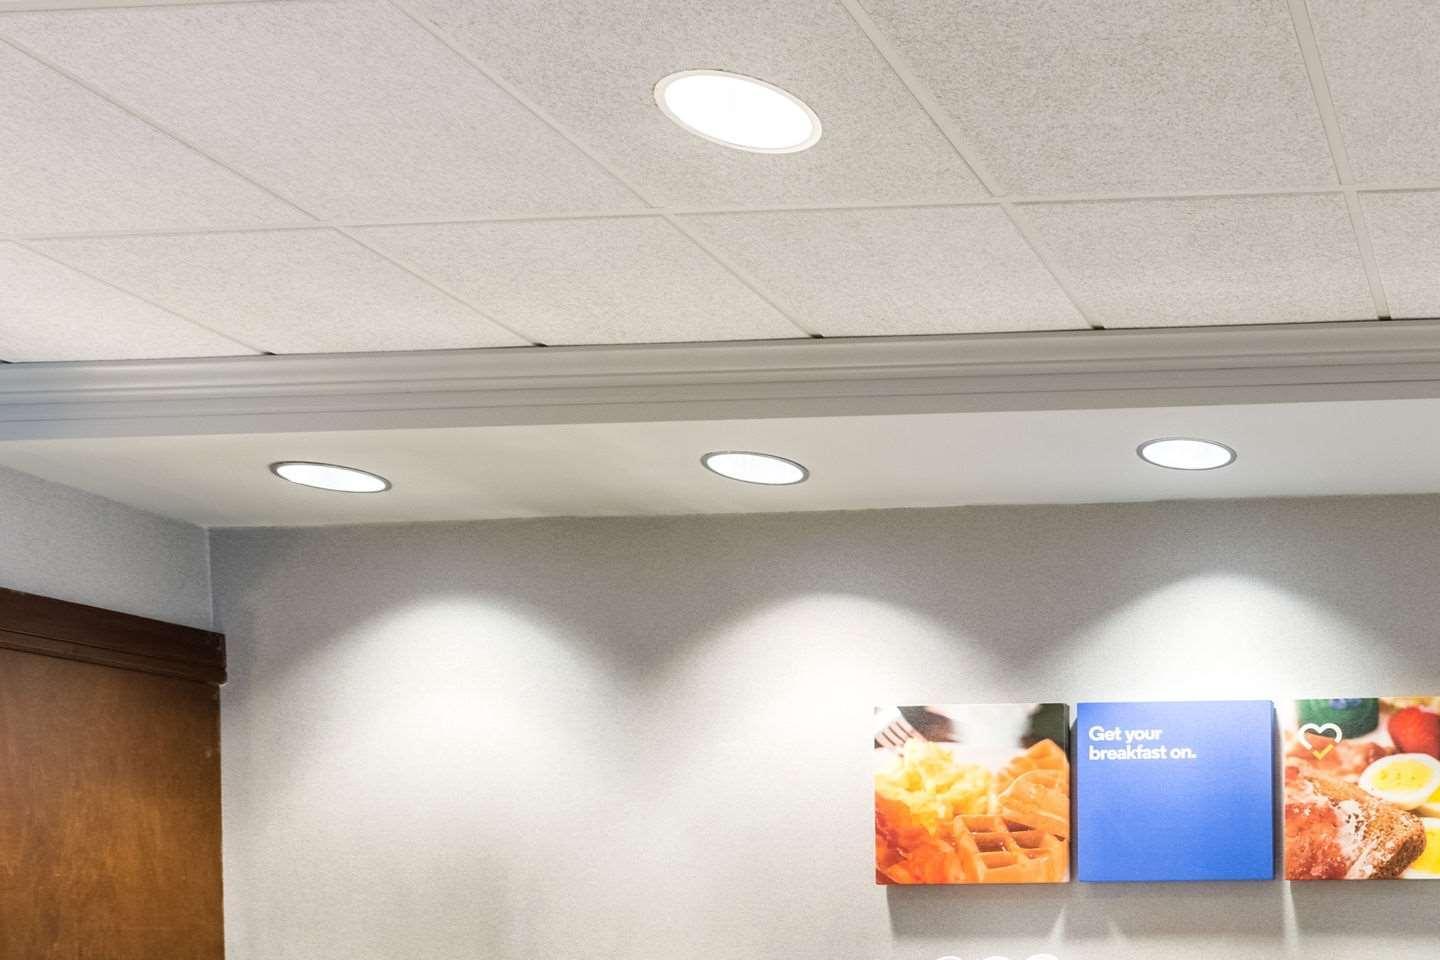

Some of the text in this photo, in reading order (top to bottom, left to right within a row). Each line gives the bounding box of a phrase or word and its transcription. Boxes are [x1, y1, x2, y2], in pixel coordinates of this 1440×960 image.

[1088, 725, 1162, 744] Get your
[1088, 743, 1197, 761] breakfast on.
